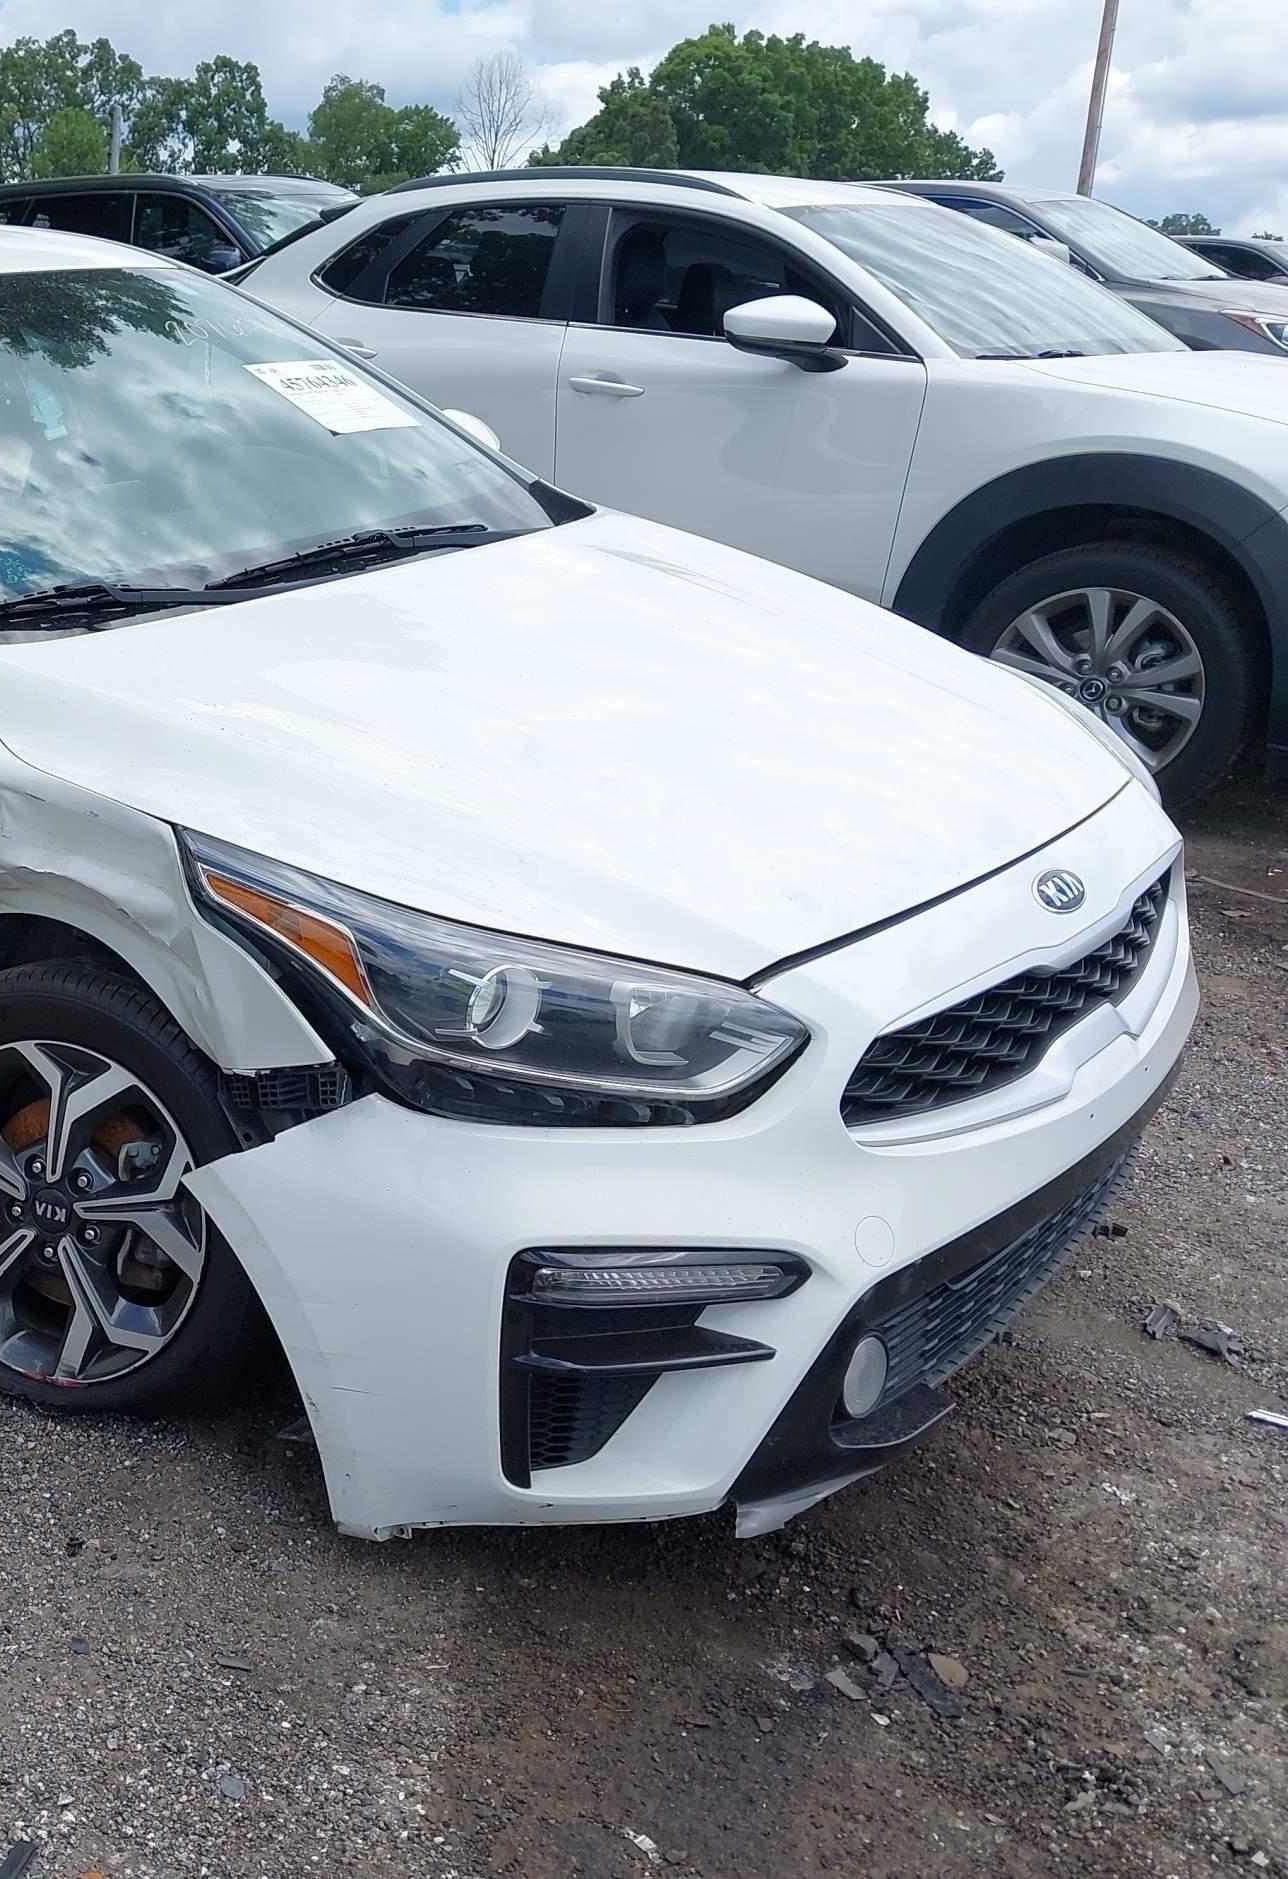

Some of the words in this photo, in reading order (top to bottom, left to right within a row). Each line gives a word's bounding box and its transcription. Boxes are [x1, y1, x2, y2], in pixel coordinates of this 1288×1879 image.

[280, 374, 358, 391] 45764346
[1038, 872, 1084, 907] KIA
[34, 1200, 67, 1224] KIA
